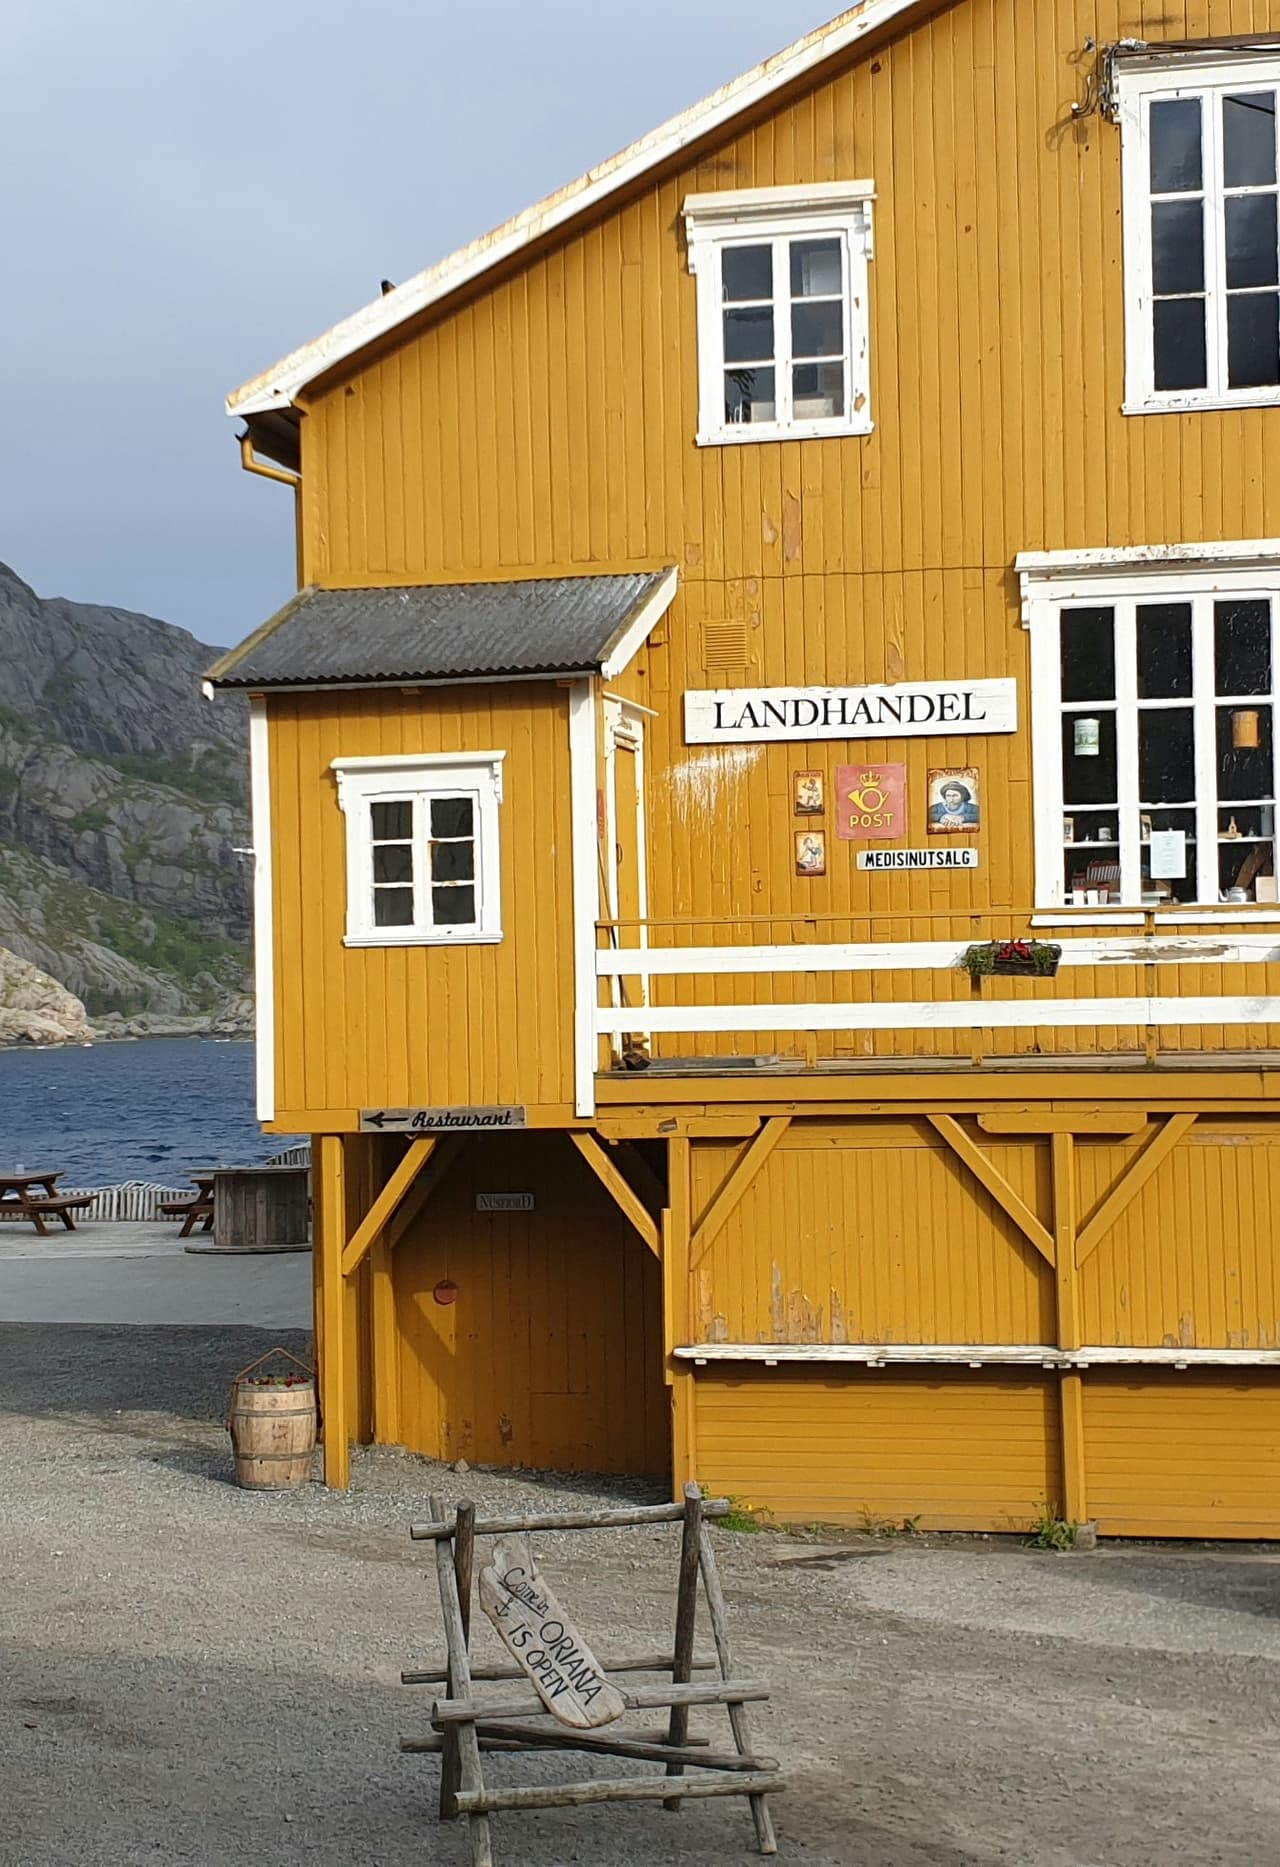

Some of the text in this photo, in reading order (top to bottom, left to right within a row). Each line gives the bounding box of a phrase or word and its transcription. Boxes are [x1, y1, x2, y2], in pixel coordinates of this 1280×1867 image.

[713, 692, 987, 730] LANDHANDEL
[849, 813, 894, 828] POST
[865, 850, 970, 868] MEDISINUTSALG
[412, 1111, 512, 1128] Restaurant
[503, 1567, 540, 1604] Come
[508, 1623, 569, 1699] IS OPEN
[539, 1620, 602, 1706] ORIANA
